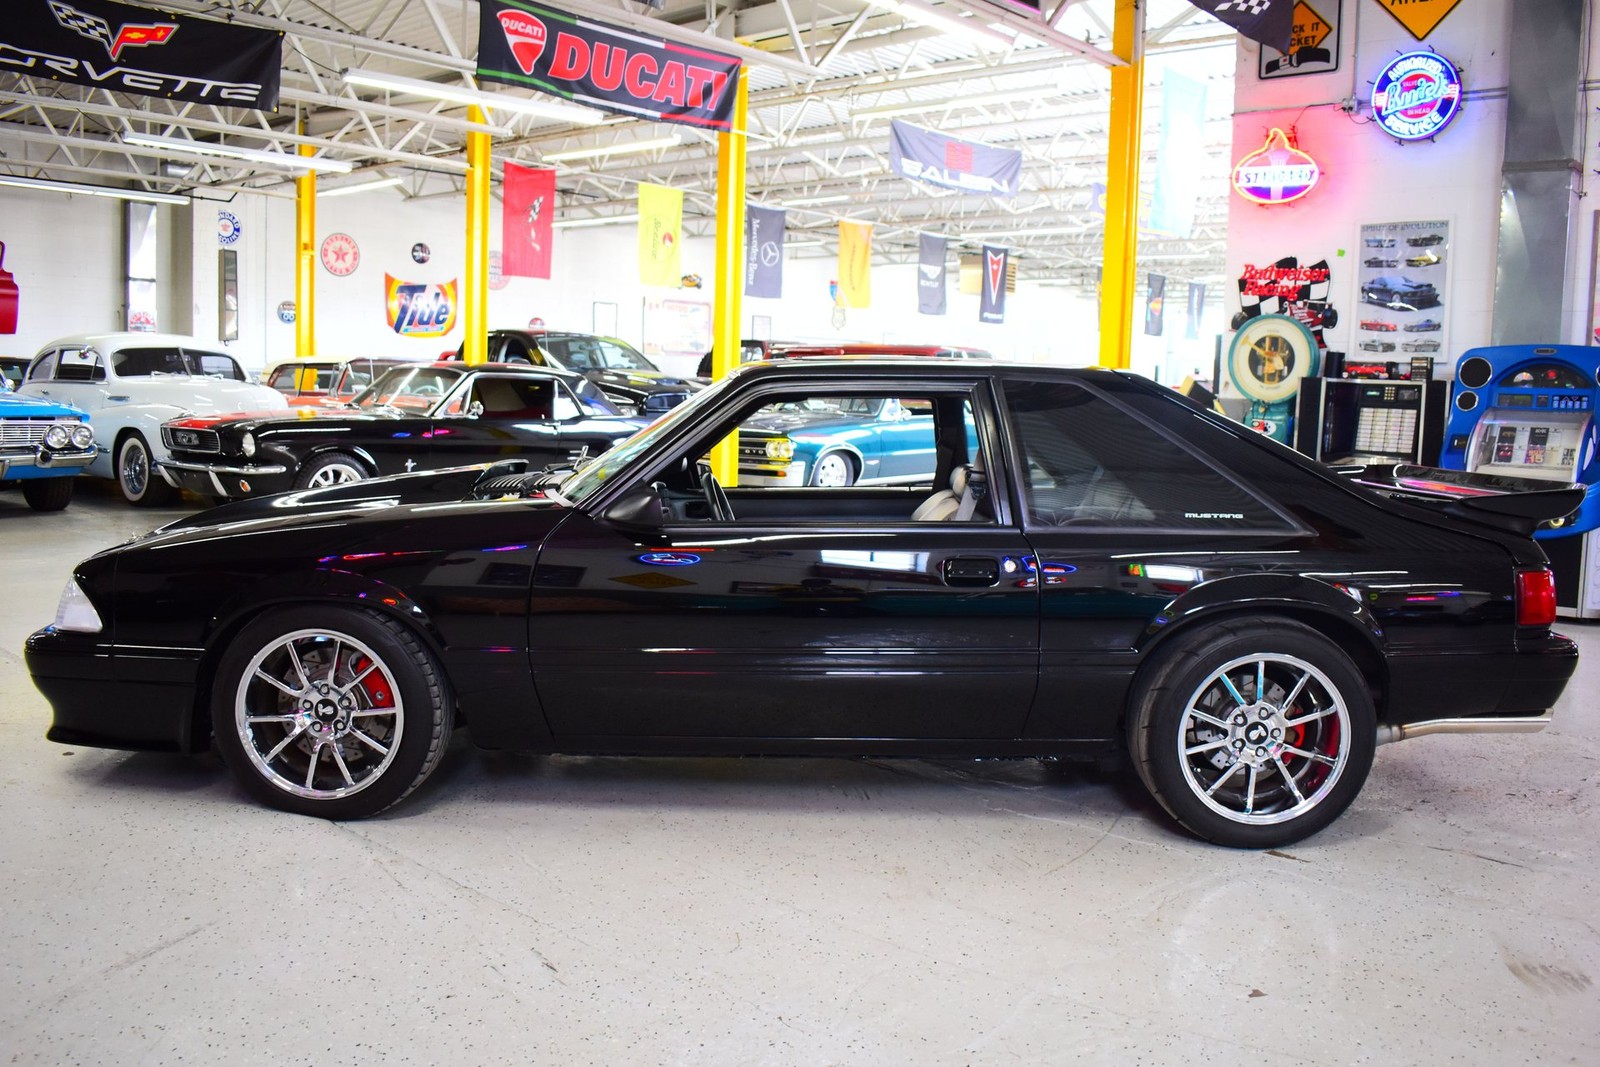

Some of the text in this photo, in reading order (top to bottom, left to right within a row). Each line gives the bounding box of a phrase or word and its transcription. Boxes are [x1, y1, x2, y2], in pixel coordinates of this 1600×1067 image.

[501, 17, 543, 37] DUCATI
[1311, 22, 1320, 32] IT
[1290, 35, 1317, 47] CKET
[0, 43, 262, 101] ORVETTE
[548, 32, 728, 110] DUCATI
[1387, 56, 1443, 81] AUTHORIZED
[1385, 111, 1443, 134] SERVICE
[901, 157, 1009, 193] SALEEN
[1400, 222, 1448, 230] EVOLUTION
[748, 218, 760, 286] Mercedes-Benz
[1241, 263, 1329, 281] Budweiser
[1243, 279, 1302, 301] Racing
[394, 284, 450, 334] Tide
